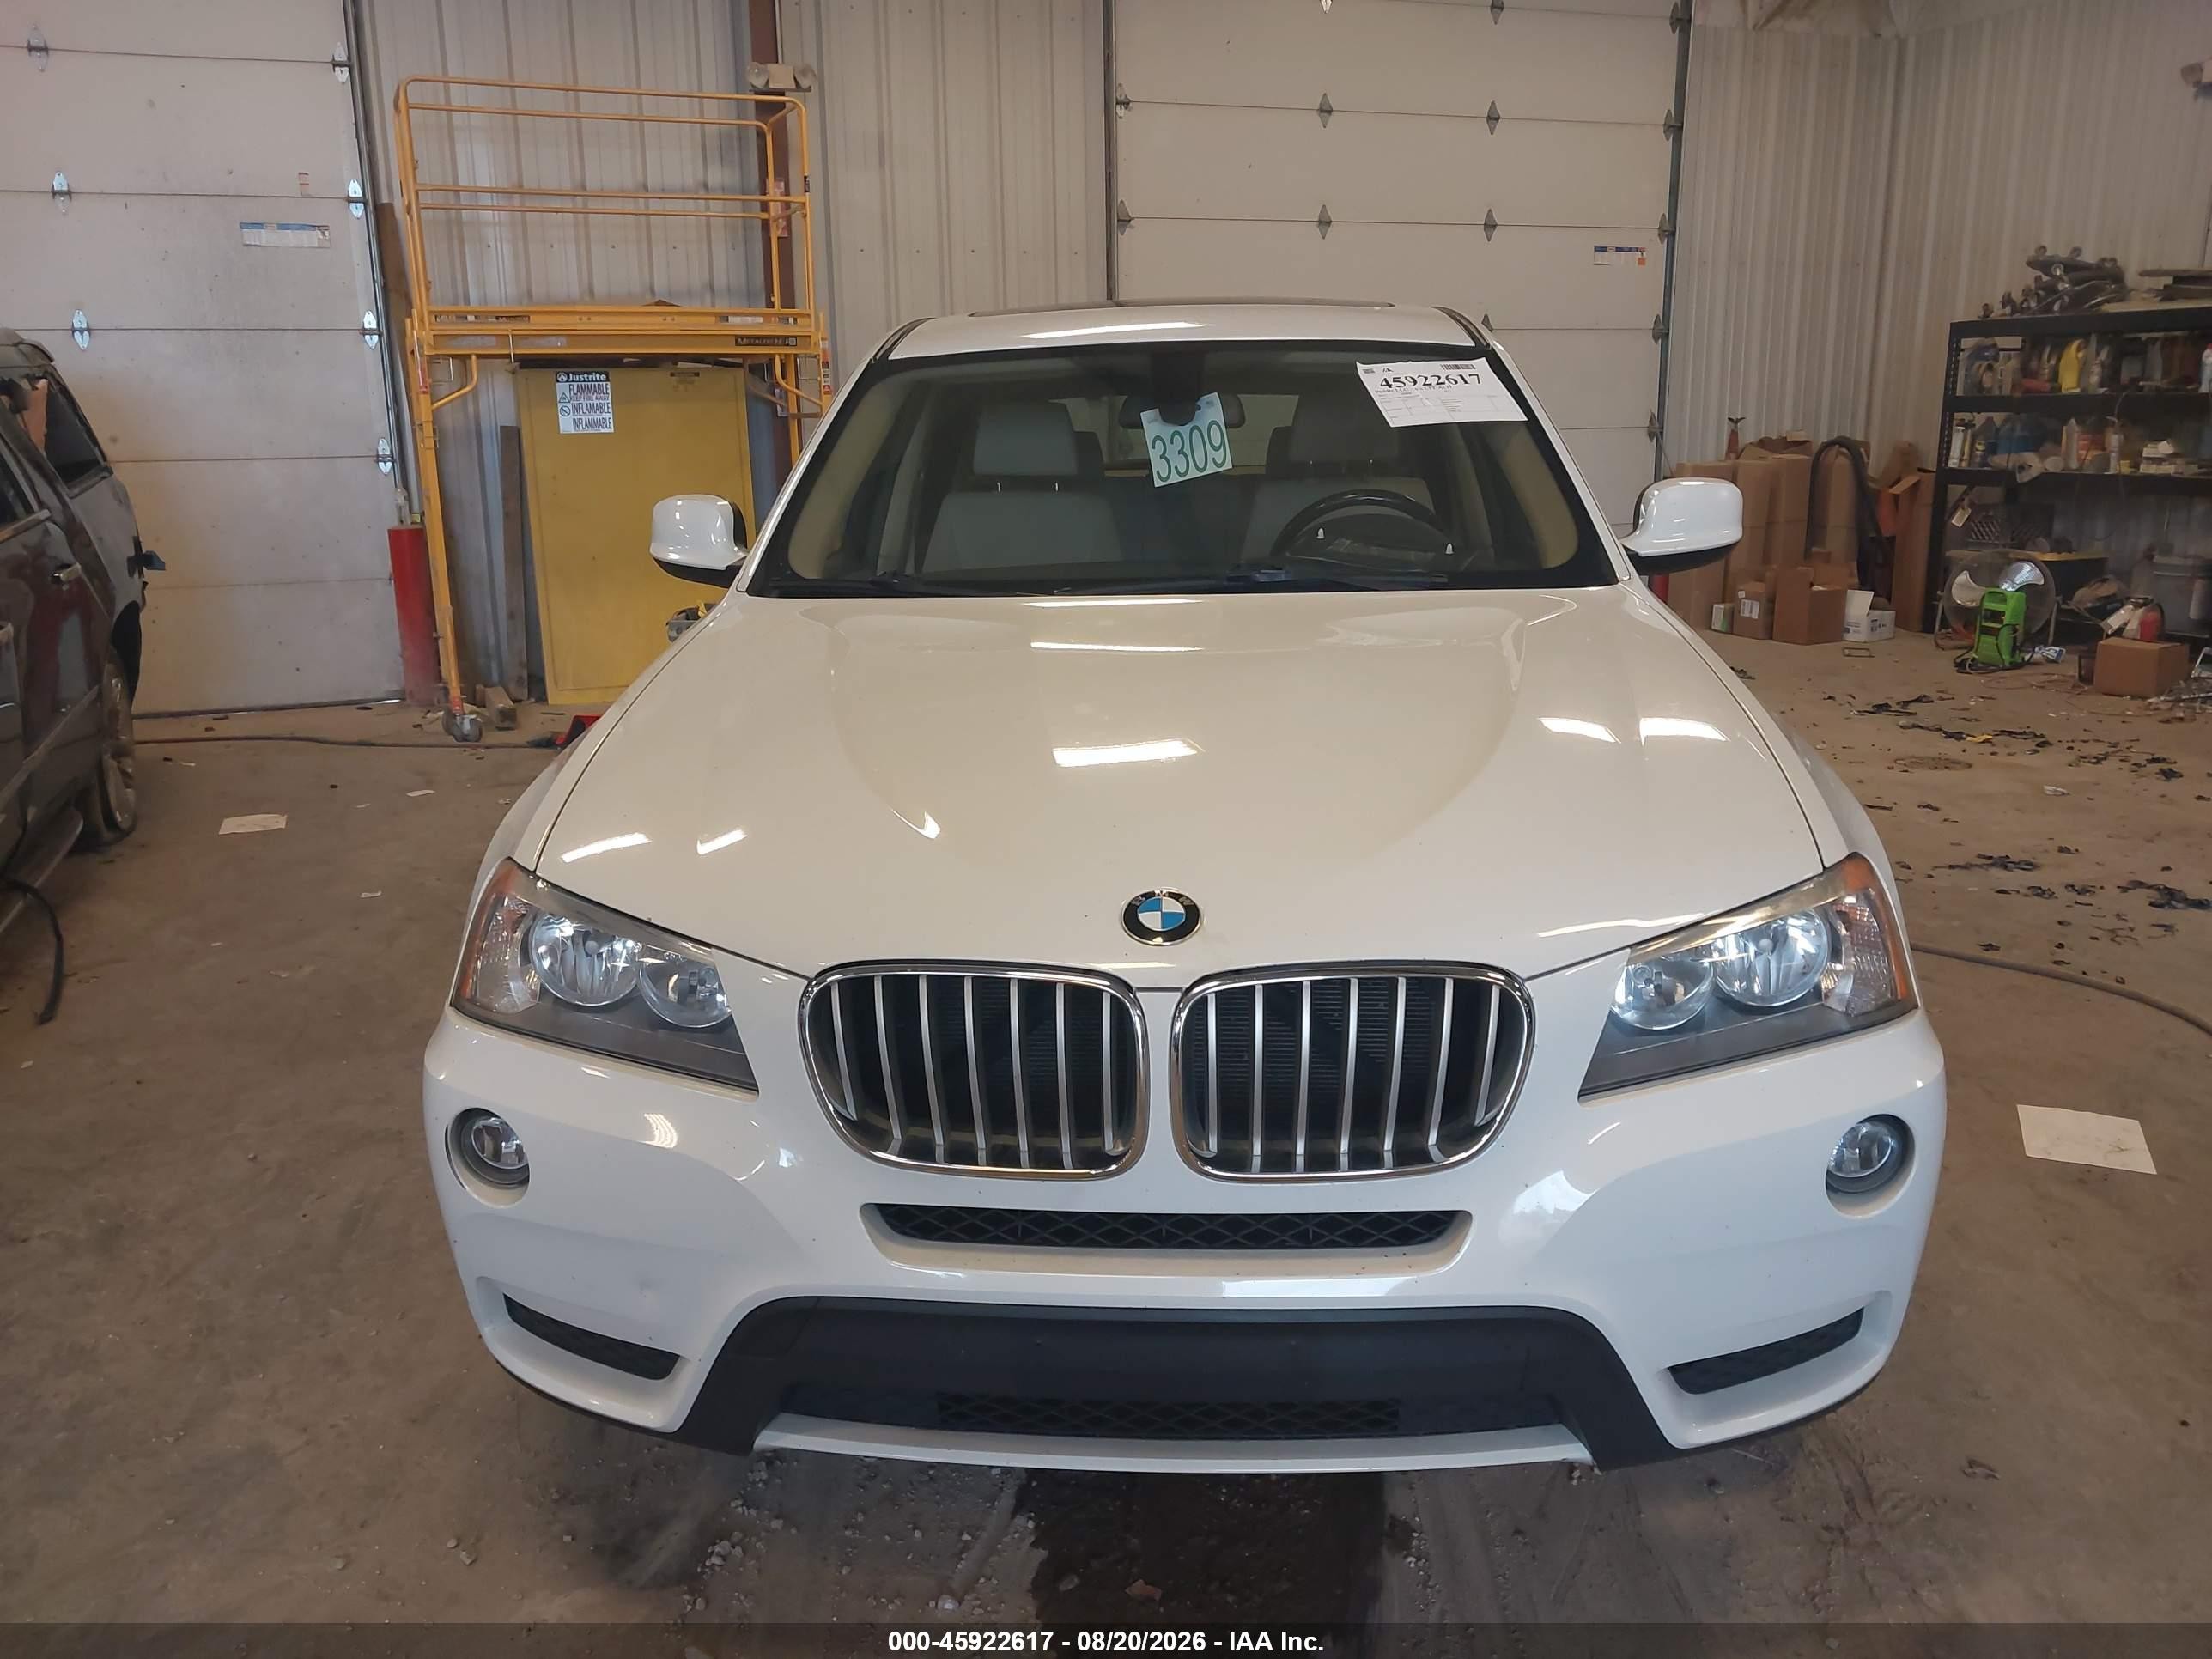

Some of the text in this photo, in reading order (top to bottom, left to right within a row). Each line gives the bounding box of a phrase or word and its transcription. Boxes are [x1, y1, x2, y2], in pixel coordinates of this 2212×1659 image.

[568, 373, 606, 381] Justrite
[1380, 374, 1481, 388] 45922617
[569, 383, 609, 395] FLAMMABLE
[572, 402, 611, 414] INFLAMABLE
[573, 417, 611, 430] INFLAMMABLE
[1152, 420, 1227, 482] 3309
